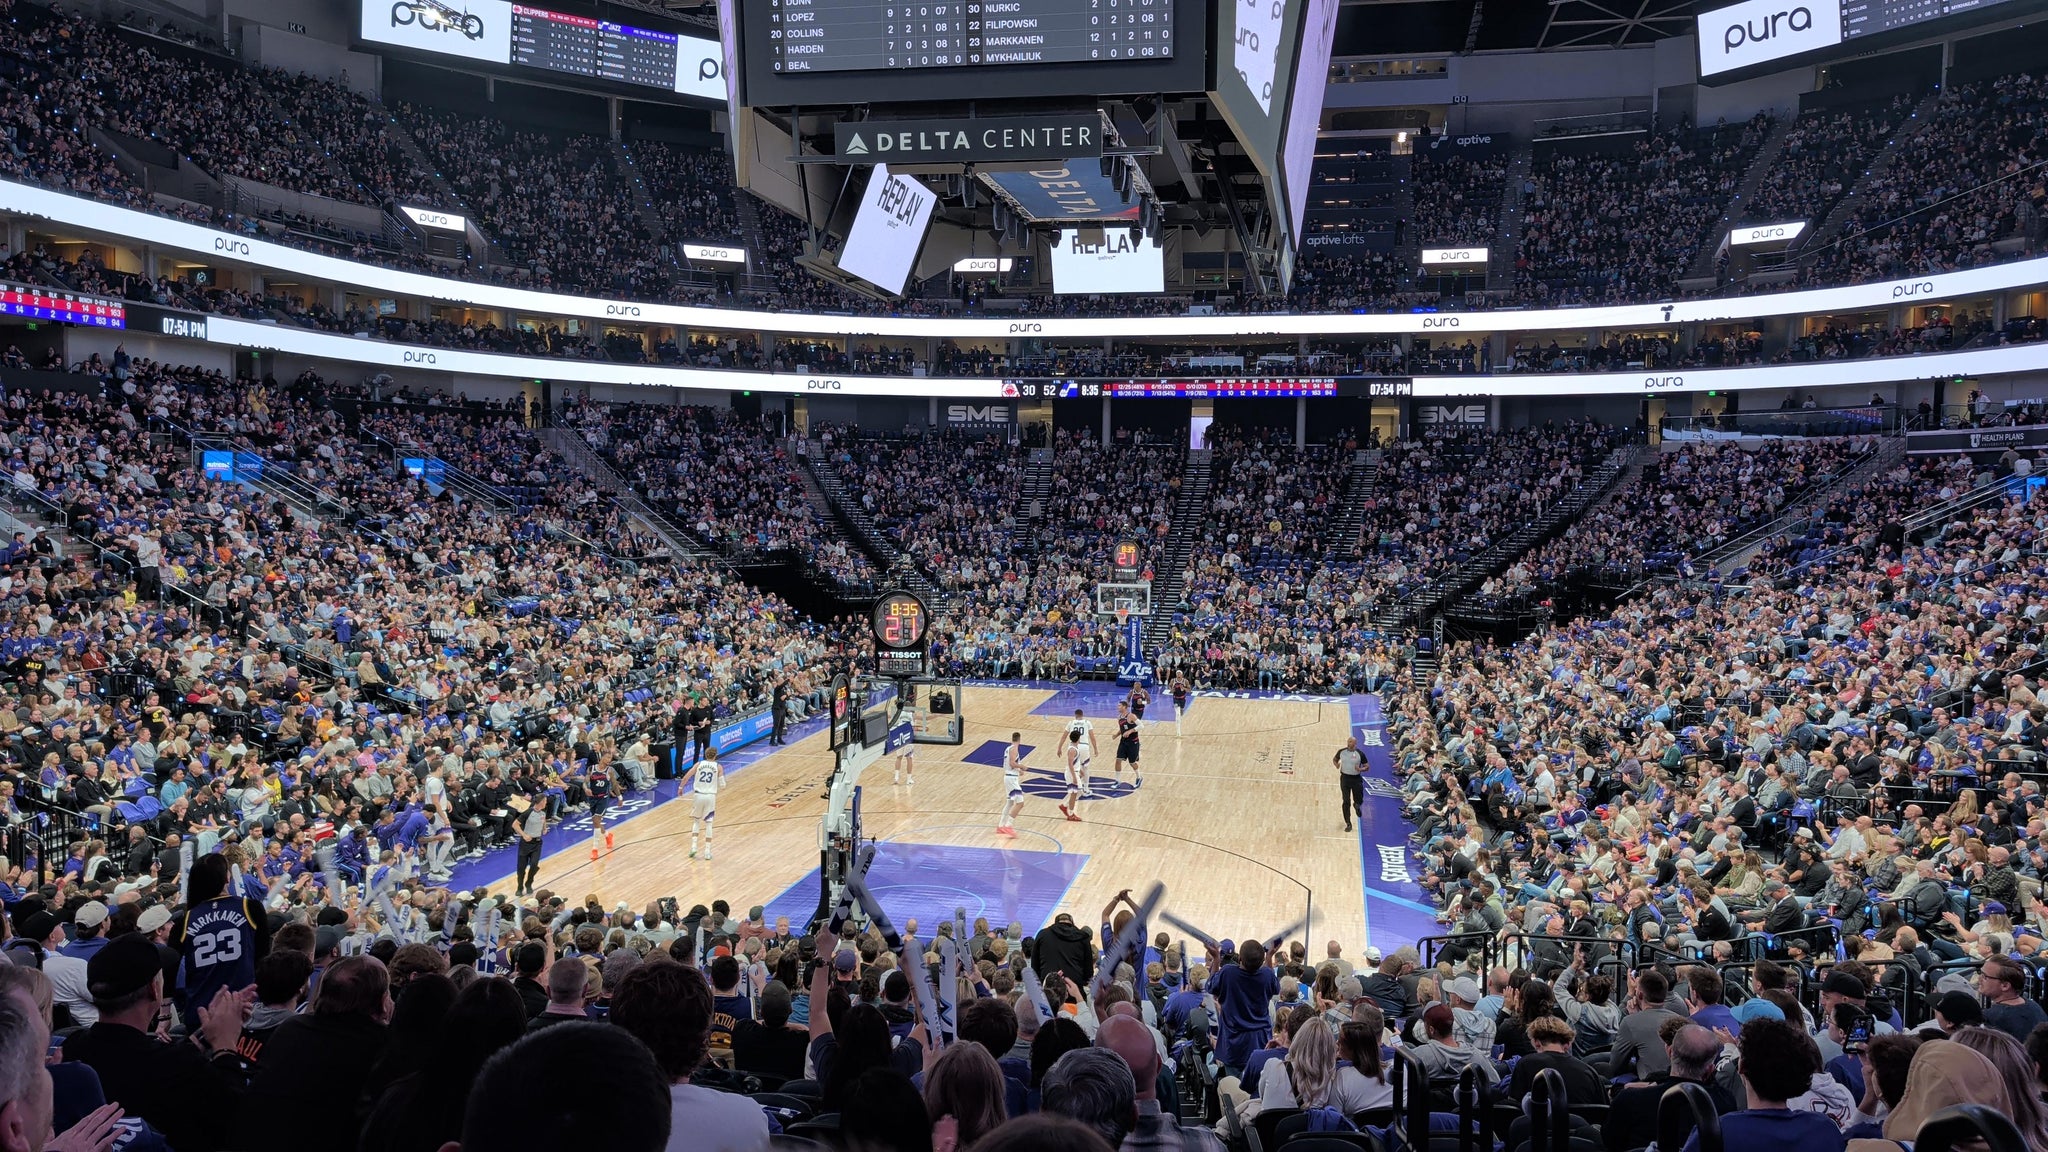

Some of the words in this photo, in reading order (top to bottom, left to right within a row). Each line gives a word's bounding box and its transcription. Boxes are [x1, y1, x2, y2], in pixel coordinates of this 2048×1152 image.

[524, 8, 548, 18] CLIPPERS
[786, 13, 814, 22] LOPEZ
[887, 9, 894, 17] 9
[906, 8, 912, 16] 2
[920, 8, 927, 16] 0
[936, 7, 947, 15] 07
[956, 6, 960, 14] 1
[968, 5, 980, 14] 30
[986, 3, 1020, 12] NURKIC
[608, 24, 622, 32] JAZZ
[968, 22, 980, 30] 22
[986, 20, 1038, 30] FILIPOWSKI
[1092, 16, 1098, 25] 0
[1111, 16, 1117, 24] 2
[1128, 15, 1134, 24] 3
[1142, 14, 1154, 22] 08
[1164, 13, 1168, 21] 1
[771, 30, 782, 38] 20
[787, 28, 824, 38] COLLINS
[888, 25, 894, 34] 2
[906, 24, 912, 32] 2
[922, 24, 926, 32] 1
[936, 23, 948, 32] 08
[956, 22, 960, 30] 1
[1724, 6, 1812, 54] pura
[969, 38, 980, 46] 23
[986, 36, 1044, 46] MARKKANEN
[1090, 33, 1100, 42] 12
[1112, 32, 1116, 41] 1
[1128, 32, 1134, 40] 2
[1144, 31, 1152, 40] 11
[1162, 30, 1168, 38] 0
[775, 46, 779, 54] 1
[788, 44, 824, 54] HARDEN
[888, 42, 894, 50] 7
[906, 41, 912, 49] 0
[922, 40, 928, 48] 3
[936, 40, 948, 48] 08
[956, 39, 960, 47] 1
[970, 54, 980, 63] 10
[986, 52, 1042, 62] MYKHAILIUK
[1092, 50, 1098, 58] 6
[1110, 49, 1117, 58] 0
[1128, 48, 1134, 56] 0
[1142, 47, 1154, 56] 08
[1162, 46, 1168, 55] 0
[774, 62, 781, 70] 0
[788, 61, 810, 70] BEAL
[888, 58, 894, 66] 3
[907, 57, 912, 65] 1
[922, 56, 928, 64] 0
[936, 55, 948, 64] 08
[955, 54, 962, 63] 0
[877, 131, 970, 152] DELTA
[983, 127, 1092, 148] CENTER
[1457, 134, 1491, 147] aptive
[1029, 168, 1102, 214] DELTA
[877, 174, 924, 226] REPLAY
[418, 212, 448, 226] pura
[1752, 226, 1784, 240] pura
[214, 235, 250, 257] pura
[1306, 236, 1340, 247] aptive
[1342, 234, 1364, 245] lofts
[700, 250, 728, 258] pura
[1441, 251, 1470, 260] pura
[970, 259, 996, 270] pura
[1892, 280, 1933, 298] pura
[34, 297, 39, 305] 2
[82, 304, 89, 312] 14
[96, 306, 105, 314] 94
[110, 308, 121, 317] 163
[606, 304, 640, 316] pura
[16, 305, 24, 314] 14
[34, 308, 39, 316] 7
[50, 310, 56, 318] 2
[66, 312, 72, 320] 4
[82, 314, 89, 322] 17
[96, 316, 106, 325] 163
[112, 318, 120, 327] 94
[1423, 316, 1460, 328] pura
[163, 318, 188, 337] 07:54
[191, 320, 206, 339] PM
[1010, 321, 1042, 334] pura
[404, 350, 436, 364] pura
[808, 380, 840, 390] pura
[1645, 376, 1684, 388] pura
[1022, 385, 1036, 396] 30
[1044, 385, 1056, 396] 52
[1082, 385, 1098, 396] 8:35
[1370, 384, 1394, 396] 07:54
[1396, 384, 1410, 396] PM
[948, 406, 1008, 422] SME
[1418, 406, 1485, 423] SME
[1982, 434, 2004, 442] HEALTH
[1116, 553, 1136, 564] 21
[891, 604, 918, 616] 8:35
[886, 616, 916, 640] 21
[1259, 694, 1348, 703] JAZZ
[720, 727, 742, 742] nutricost
[700, 772, 714, 784] 23
[1376, 844, 1412, 884] SEATGEEK
[186, 910, 248, 937] MARKKANEN
[193, 928, 242, 968] 23
